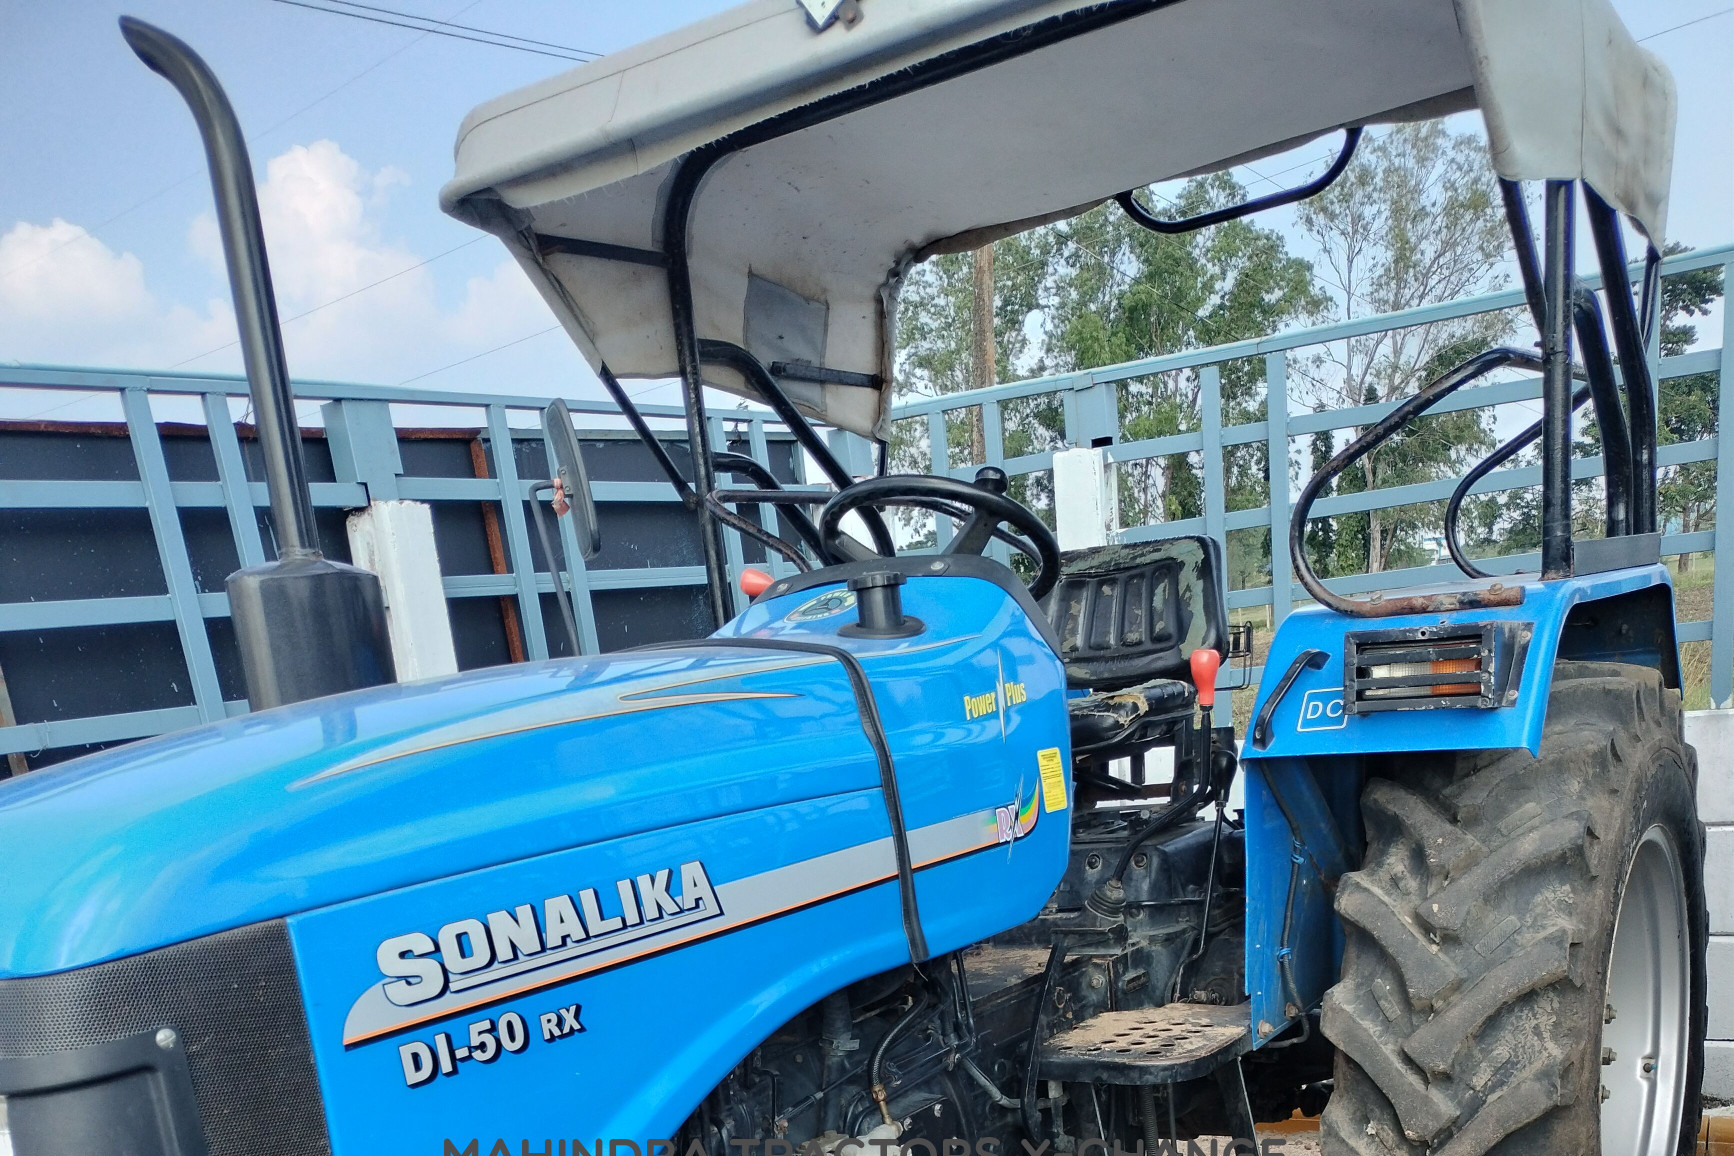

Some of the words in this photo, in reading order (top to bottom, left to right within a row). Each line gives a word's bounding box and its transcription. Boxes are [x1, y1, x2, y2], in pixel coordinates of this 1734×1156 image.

[963, 691, 997, 721] Power
[1004, 681, 1027, 708] Plus
[1306, 699, 1344, 719] DC
[995, 803, 1025, 843] RX
[376, 860, 722, 1006] SONALIKA
[398, 1011, 529, 1088] DI-50
[540, 1003, 587, 1043] RX
